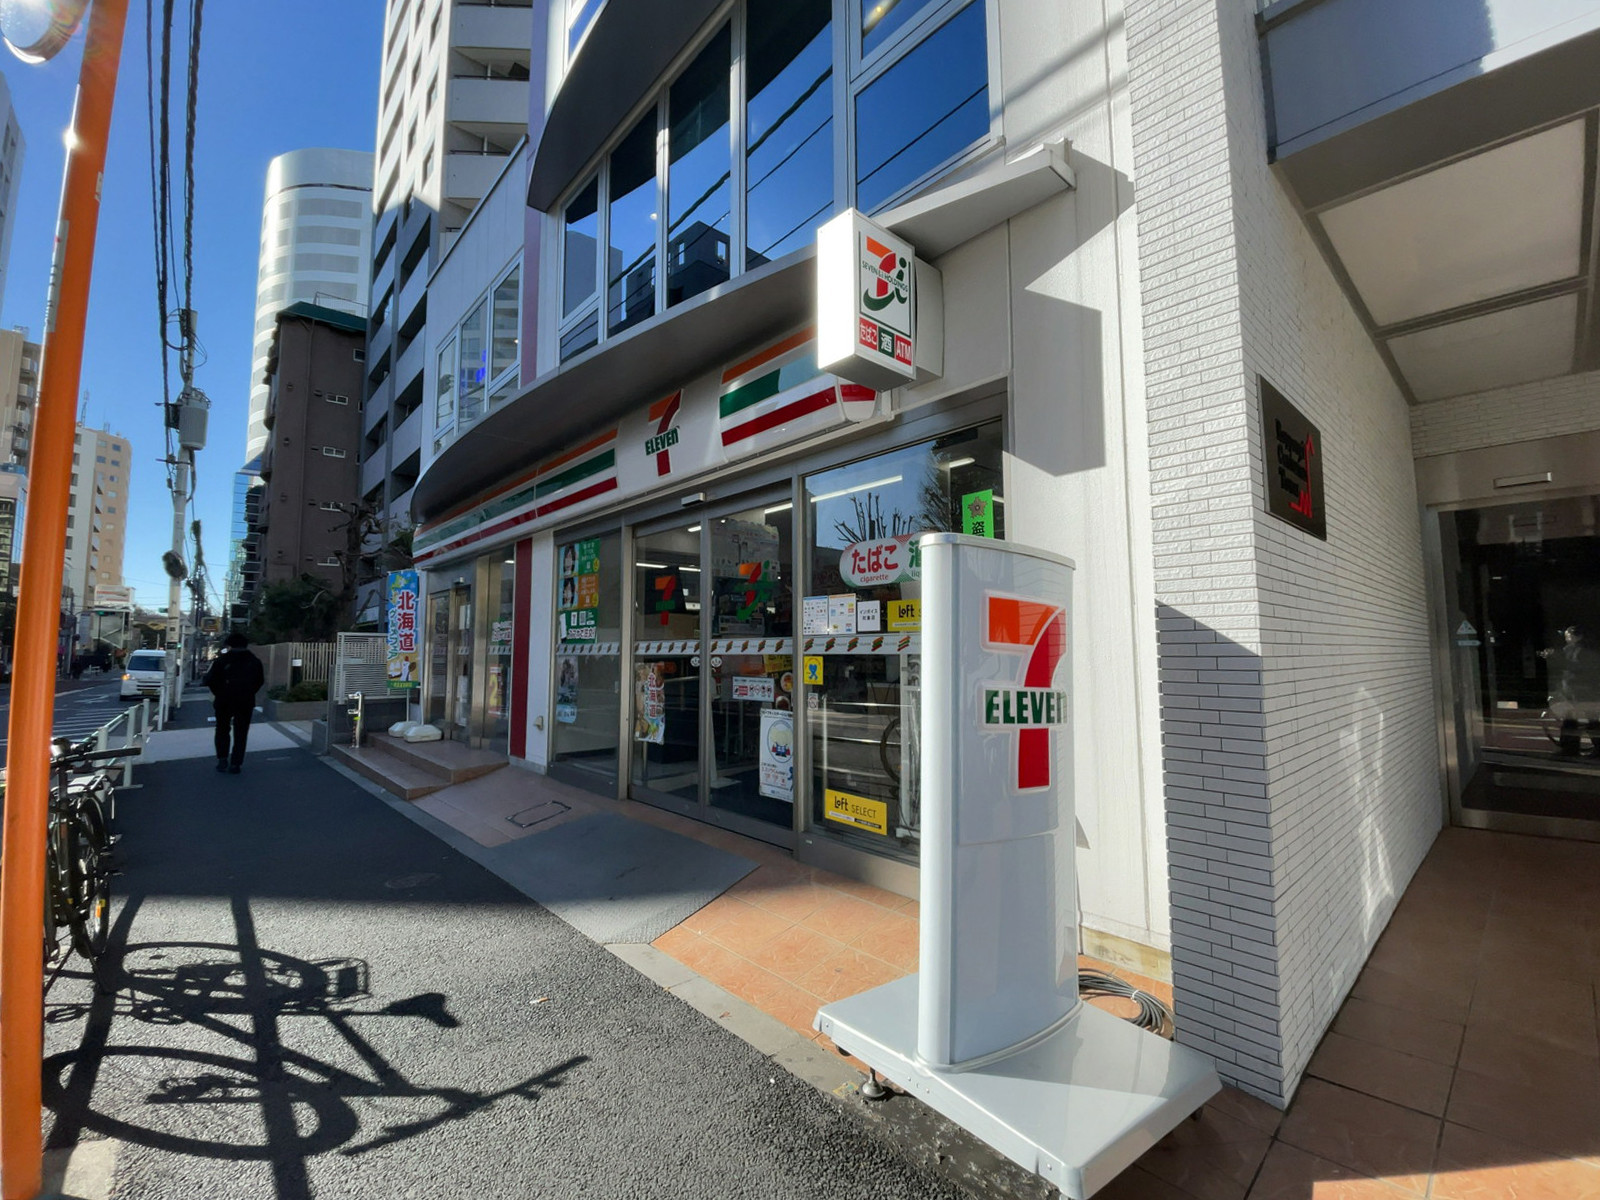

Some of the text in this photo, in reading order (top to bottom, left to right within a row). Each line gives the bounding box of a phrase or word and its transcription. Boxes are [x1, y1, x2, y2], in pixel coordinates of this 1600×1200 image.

[860, 322, 877, 346] たばこ
[880, 332, 893, 353] 酒
[896, 340, 912, 362] ATM
[851, 544, 899, 575] たばこ
[860, 573, 889, 583] cigarette
[397, 591, 415, 651] 北海道
[851, 804, 877, 819] SELECT
